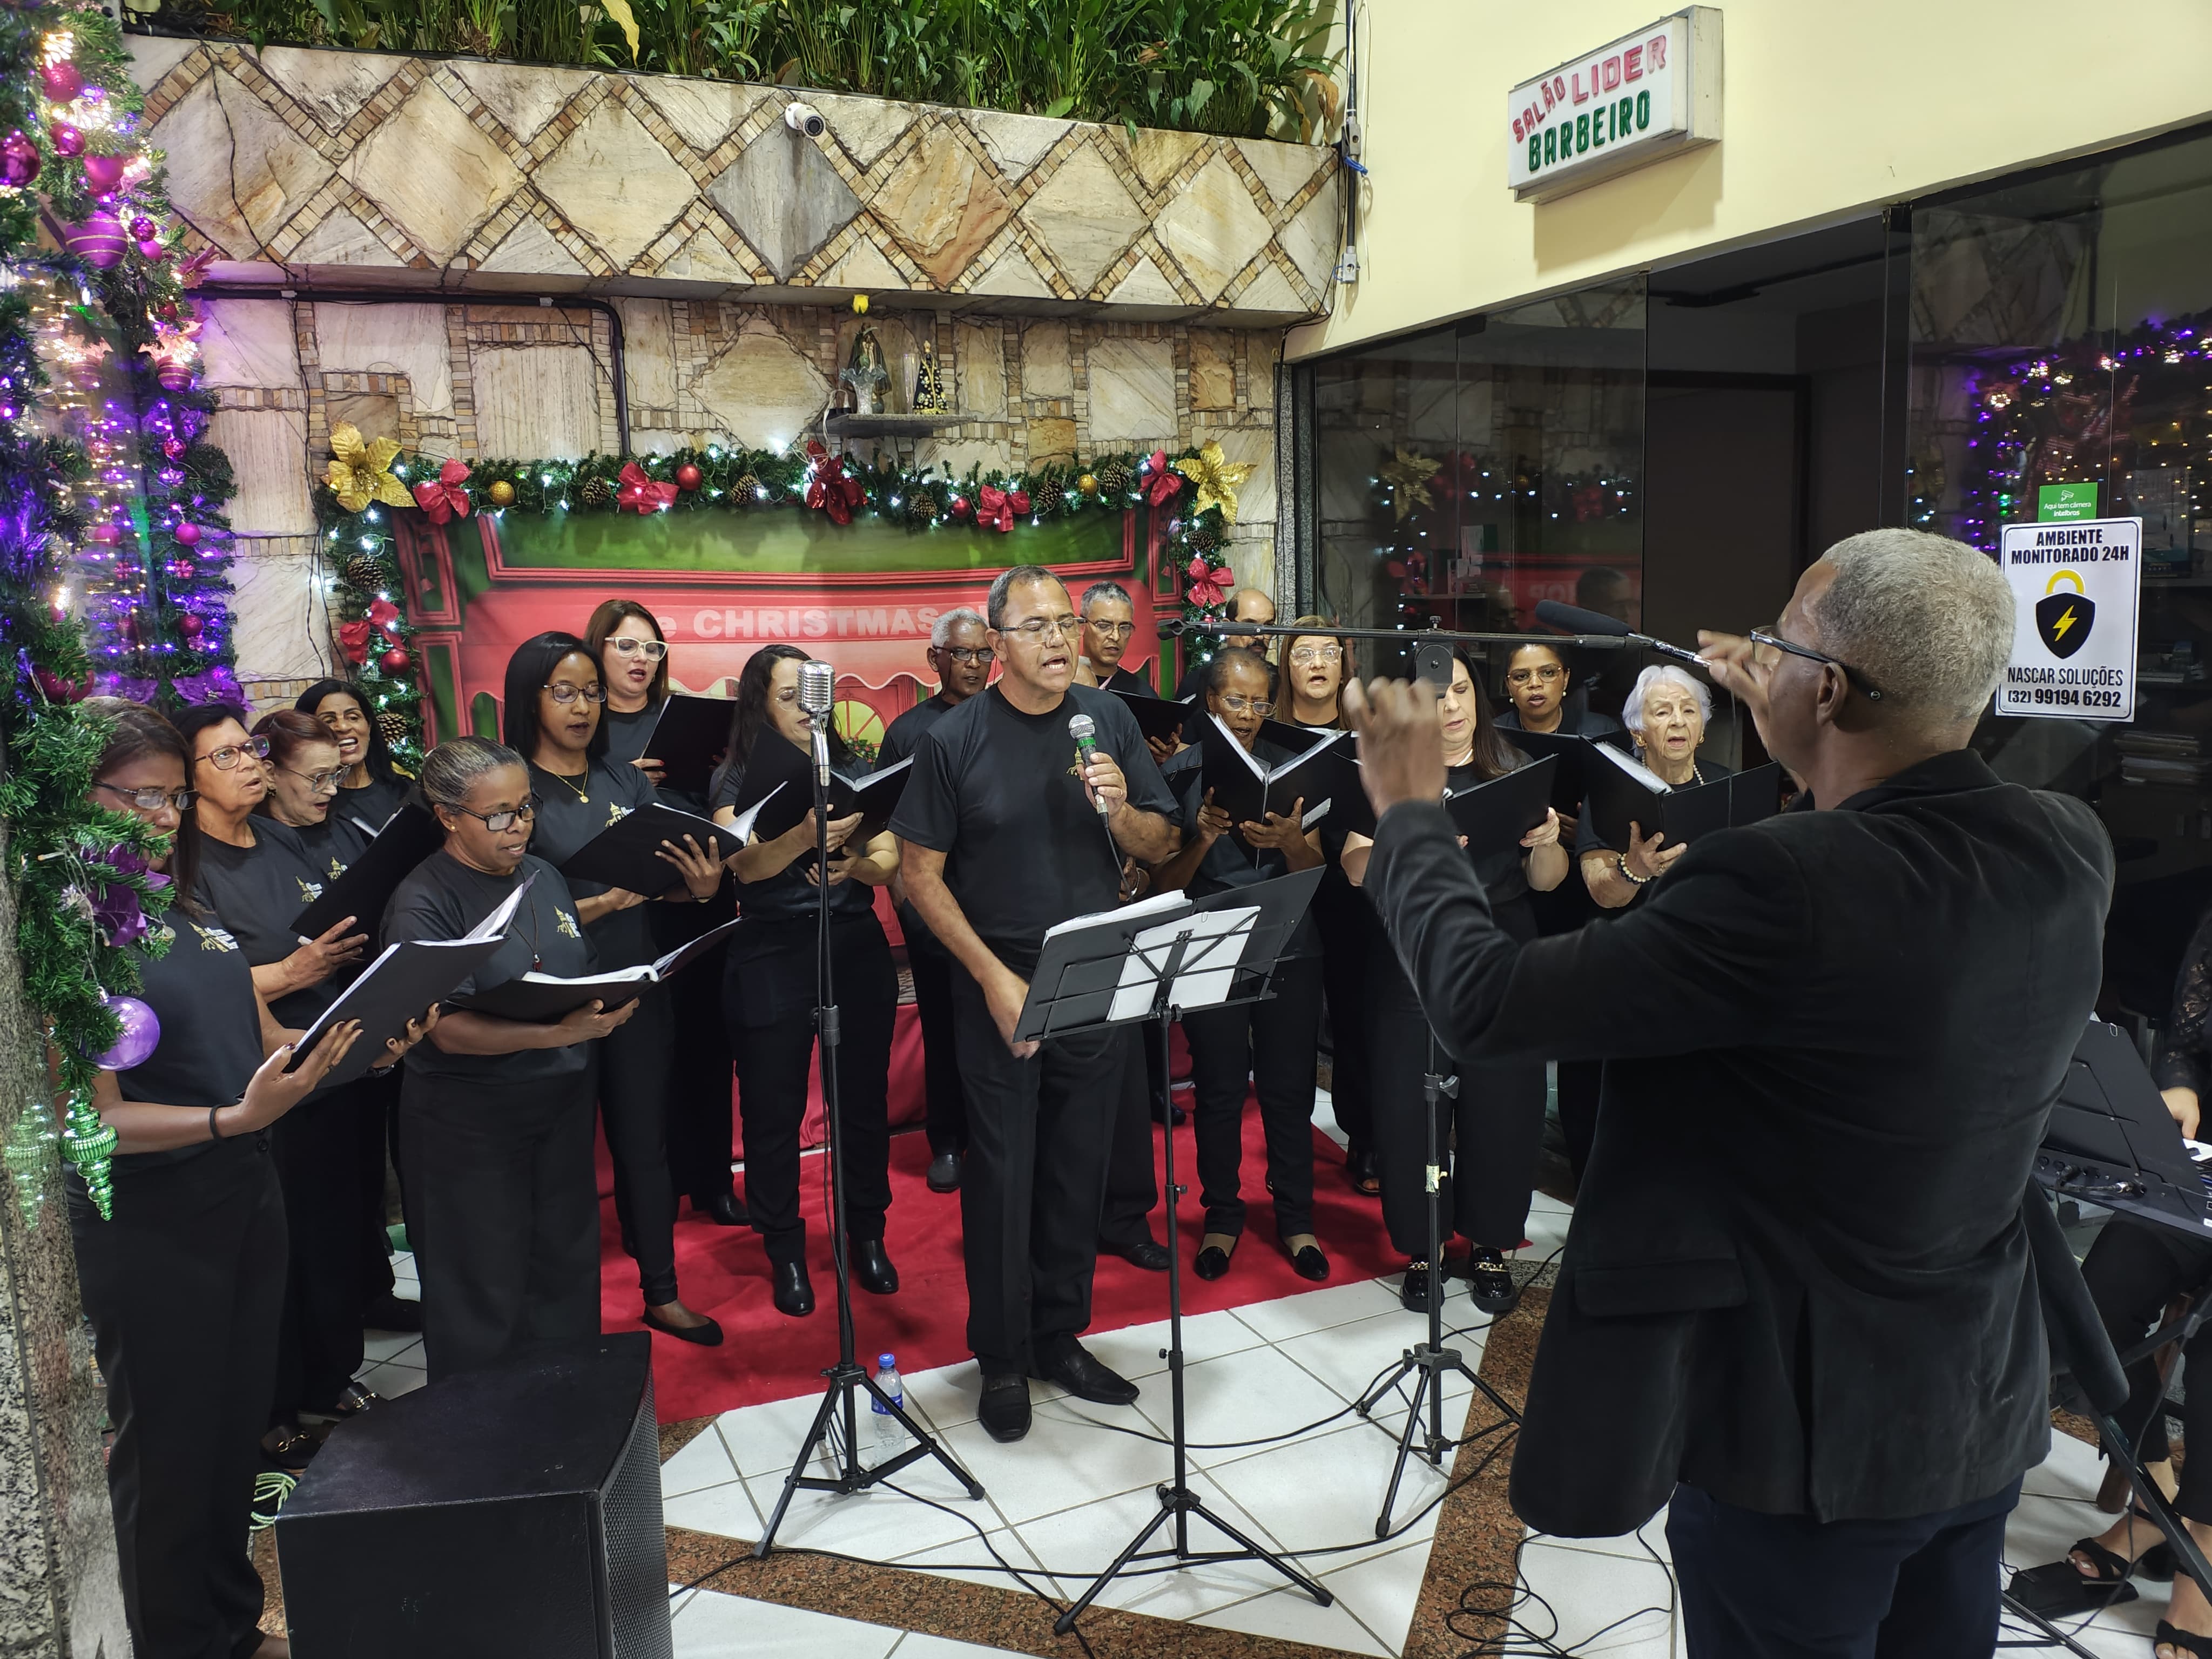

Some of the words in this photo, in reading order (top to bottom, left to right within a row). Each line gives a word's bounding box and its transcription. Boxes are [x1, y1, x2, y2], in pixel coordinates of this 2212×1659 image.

[1513, 76, 1566, 143] SALÃO
[1572, 35, 1667, 104] LIDER
[1529, 89, 1650, 172] BARBEIRO
[2036, 529, 2102, 546] AMBIENTE
[2011, 548, 2098, 564] MONITORADO
[2102, 545, 2129, 561] 24H
[693, 607, 939, 638] CHRISTMAS
[2008, 667, 2055, 684] NASCAR
[2058, 666, 2123, 689] SOLUÇÕES
[2008, 690, 2032, 703] (32)
[2035, 689, 2079, 705] 99194
[2083, 691, 2121, 707] 6292
